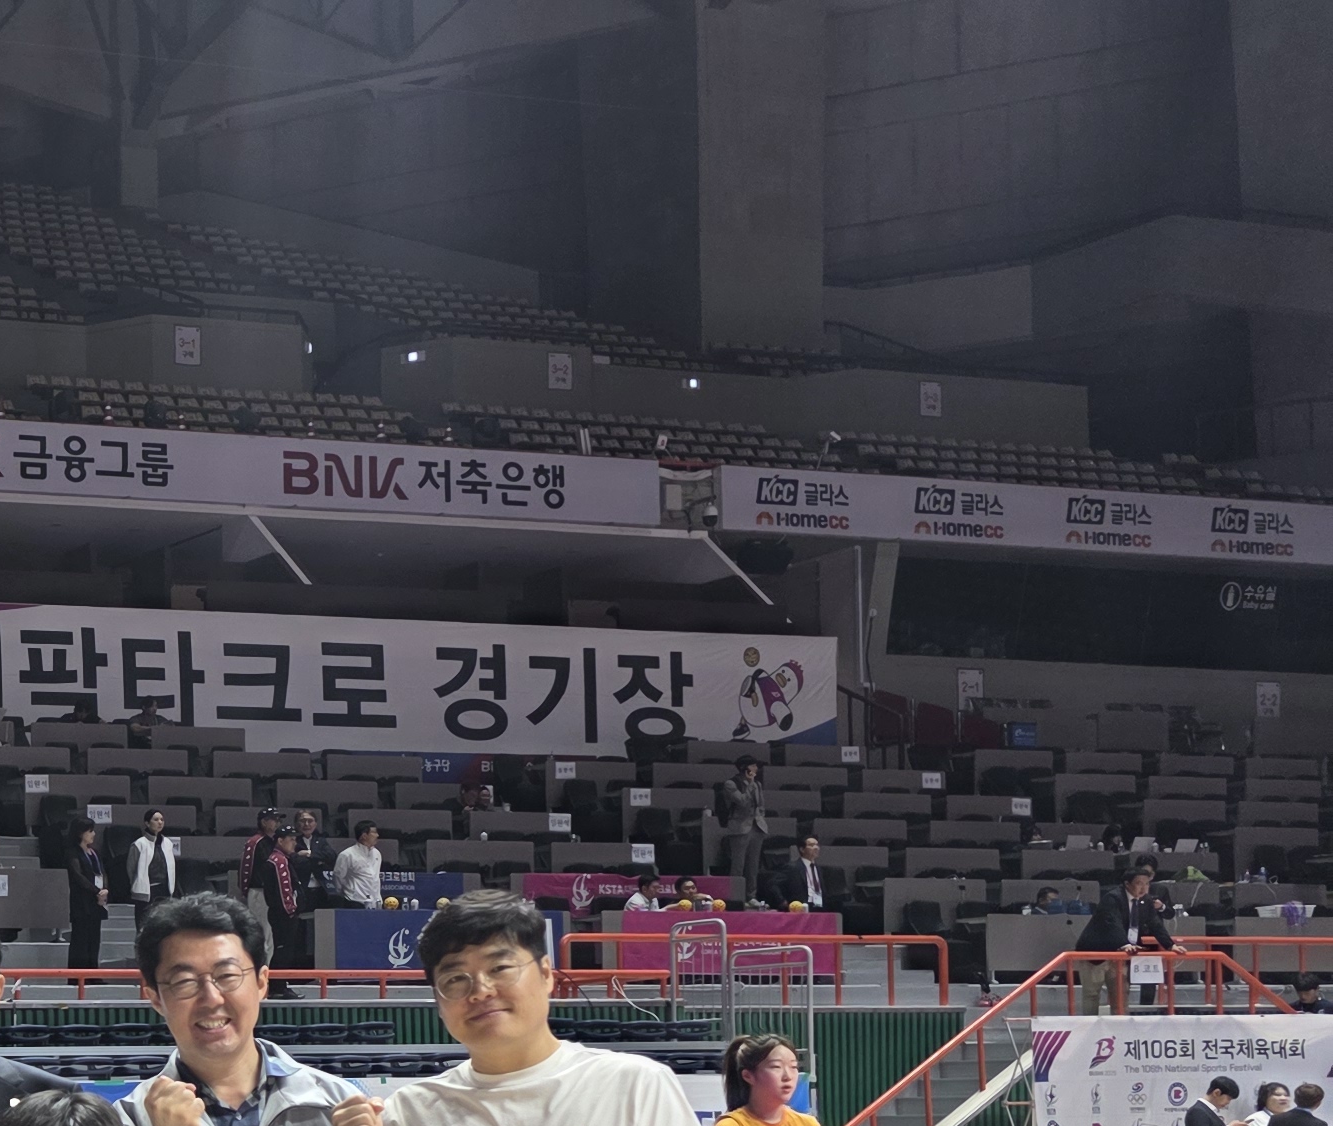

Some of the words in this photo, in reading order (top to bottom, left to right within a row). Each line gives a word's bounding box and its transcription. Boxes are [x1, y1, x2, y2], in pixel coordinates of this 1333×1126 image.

[178, 337, 196, 349] 3-1
[12, 434, 175, 487] 금융그룹
[282, 450, 410, 500] BNK
[416, 459, 566, 512] 저축은행
[760, 477, 796, 504] KCC
[804, 482, 850, 507] 글라스
[918, 486, 953, 513] KCC
[960, 493, 1004, 516] 글라스
[1070, 497, 1103, 523] KCC
[1110, 503, 1152, 526] 글라스
[1214, 507, 1247, 531] KCC
[1253, 512, 1294, 535] 글라스
[434, 636, 695, 742] 경기장
[961, 681, 979, 693] 2-1
[1124, 1039, 1195, 1060] 제106회
[1202, 1038, 1306, 1060] 전국체육대회
